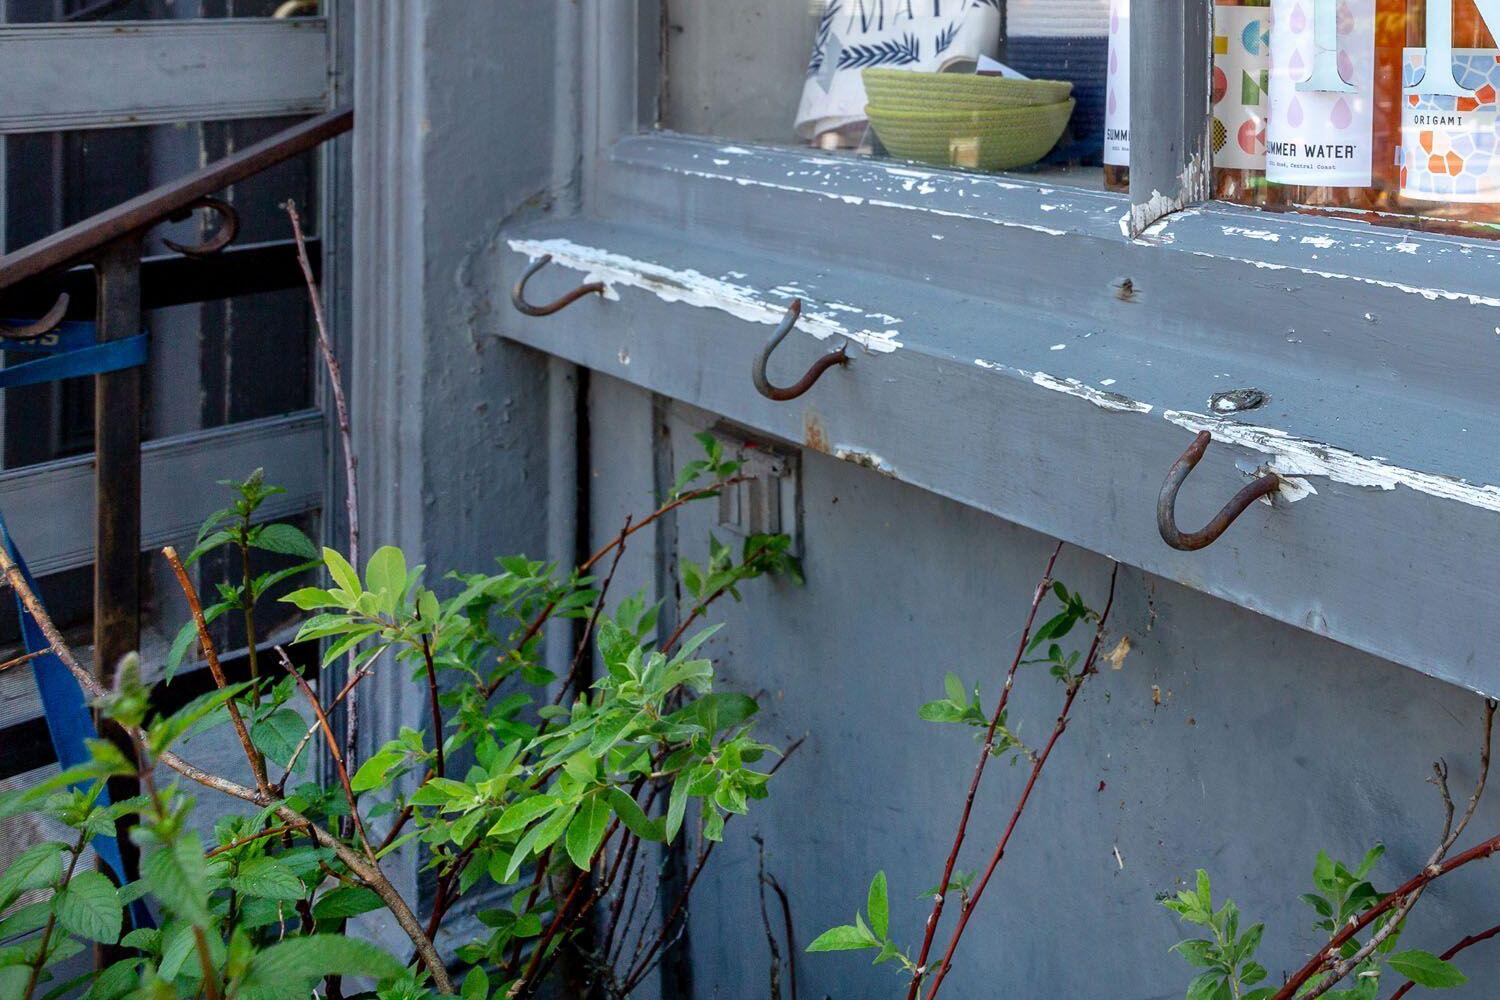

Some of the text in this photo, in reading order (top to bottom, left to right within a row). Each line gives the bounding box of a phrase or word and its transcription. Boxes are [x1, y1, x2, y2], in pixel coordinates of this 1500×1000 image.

[1414, 115, 1464, 127] ORIGAMI
[1107, 128, 1130, 141] SUMM
[1267, 141, 1354, 159] UMMER WATER
